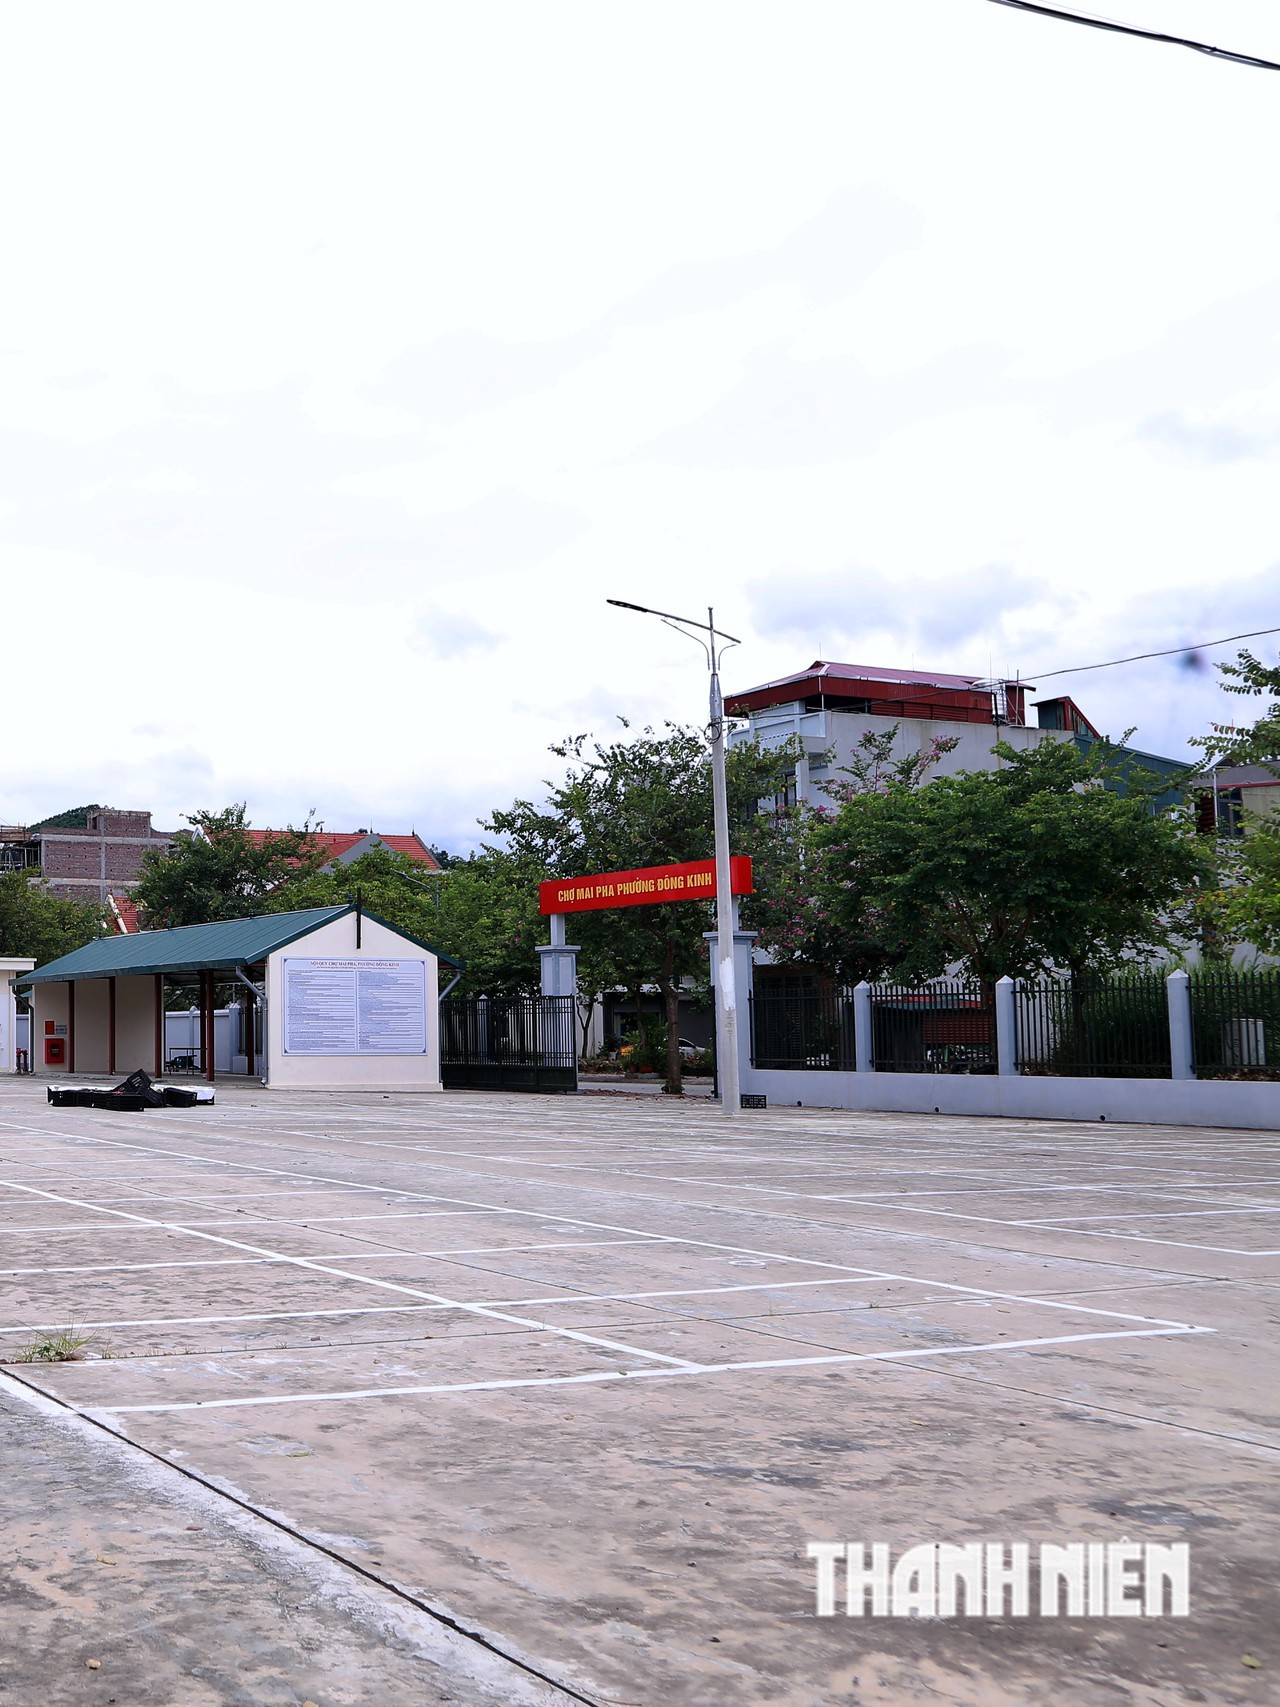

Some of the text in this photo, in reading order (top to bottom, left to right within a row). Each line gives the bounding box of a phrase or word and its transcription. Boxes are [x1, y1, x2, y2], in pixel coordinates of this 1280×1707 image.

[558, 872, 712, 904] CHỢ MAI PHA PHƯỜNG ĐÔNG KINH
